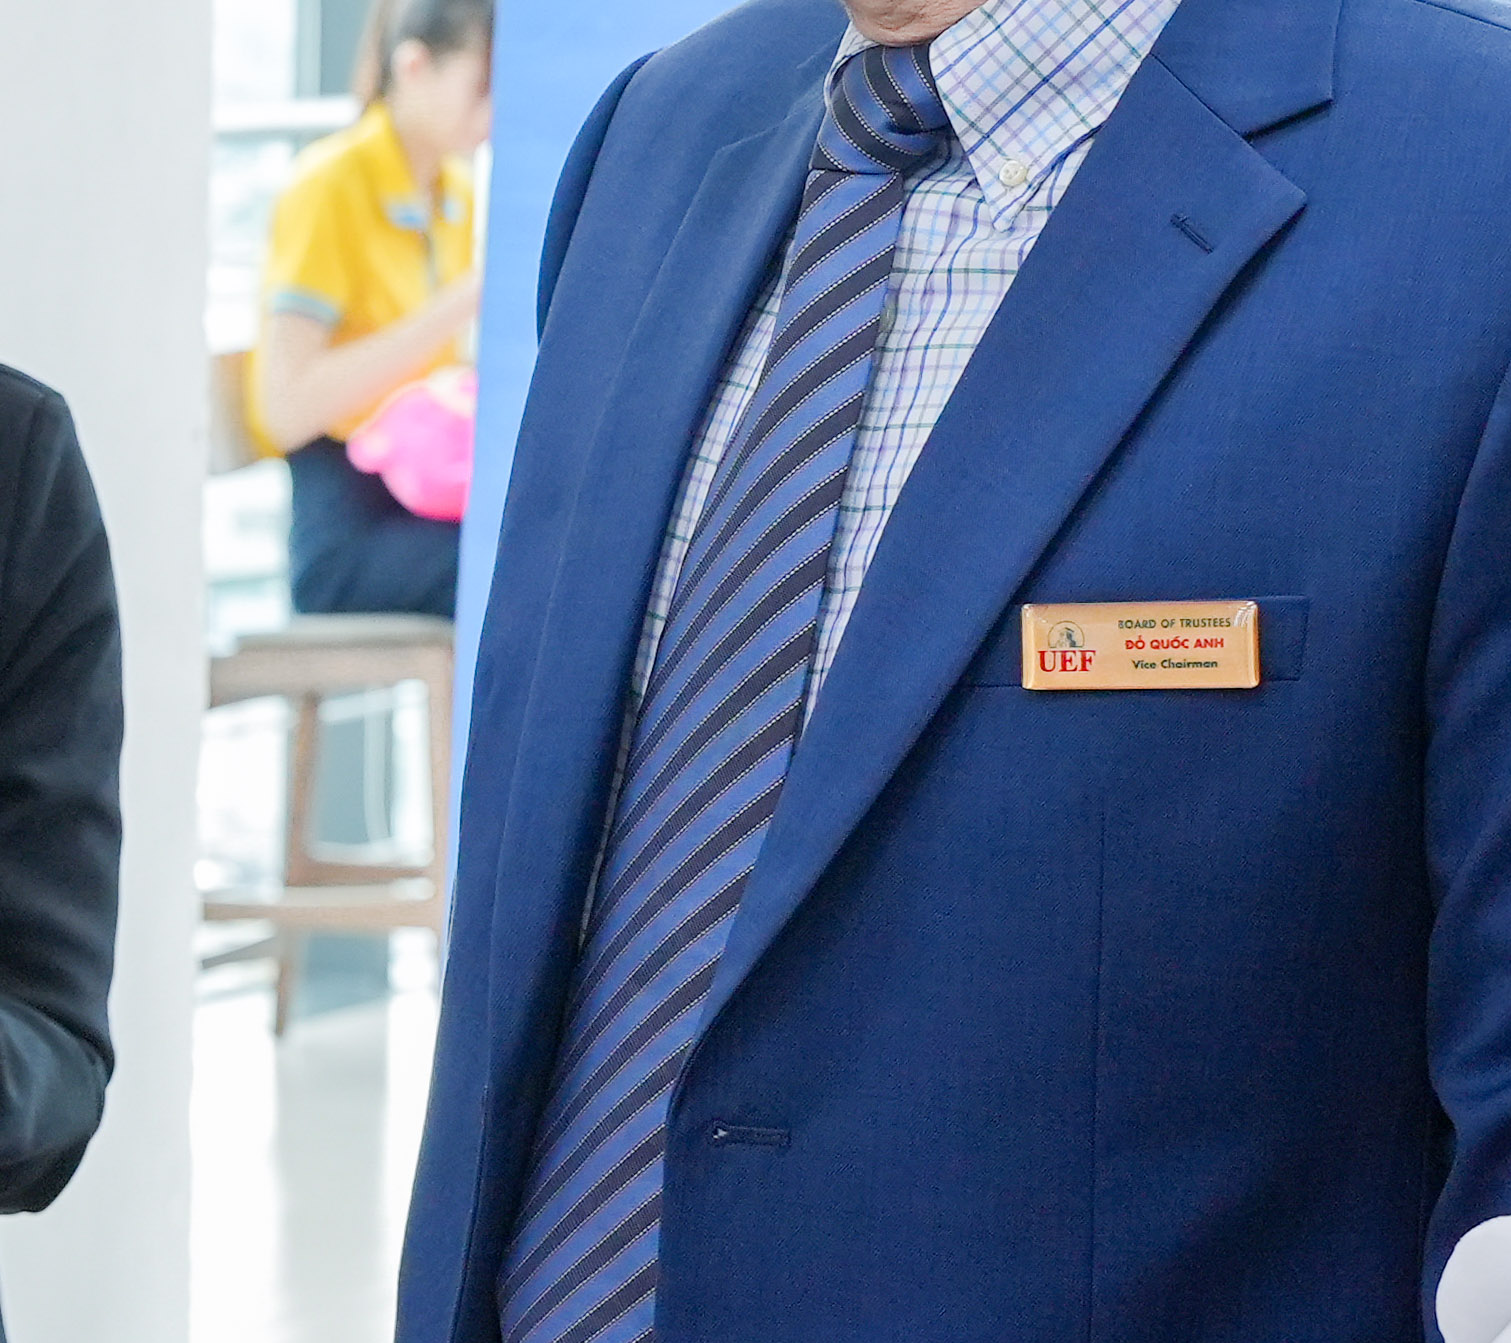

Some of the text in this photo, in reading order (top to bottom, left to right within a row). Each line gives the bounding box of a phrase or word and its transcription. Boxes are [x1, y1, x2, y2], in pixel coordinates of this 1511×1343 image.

[1118, 618, 1231, 629] BOARD OF TRUSTEES
[1150, 636, 1189, 649] QUỐC
[1194, 638, 1224, 649] ANH
[1038, 650, 1096, 672] UEF
[1131, 659, 1218, 669] Vice Chairman
